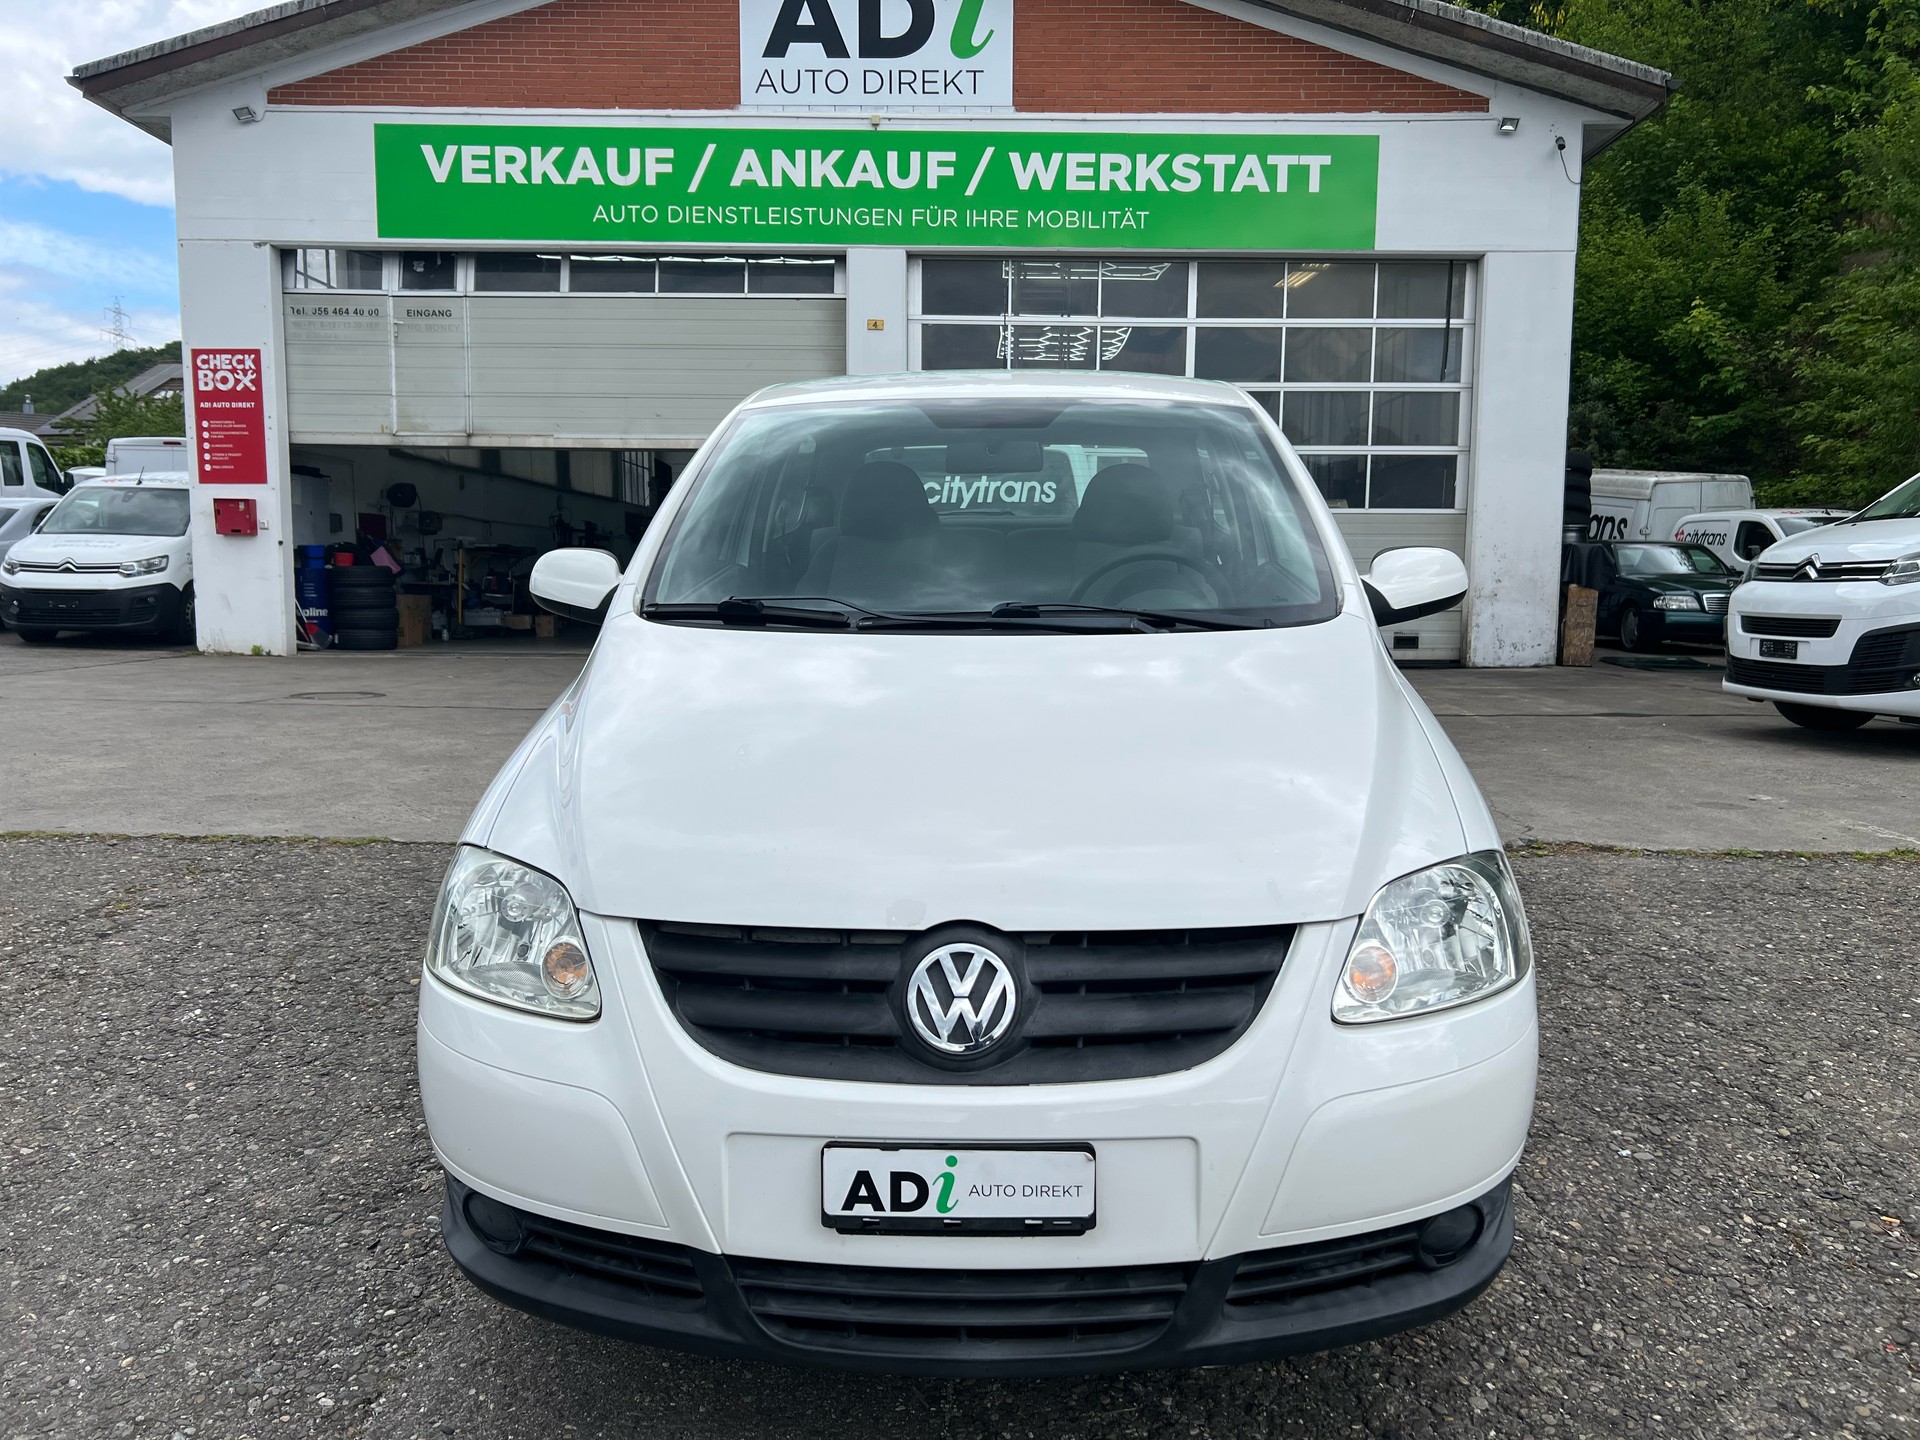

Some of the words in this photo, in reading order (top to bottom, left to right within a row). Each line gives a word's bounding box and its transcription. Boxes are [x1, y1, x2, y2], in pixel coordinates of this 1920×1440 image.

[755, 69, 848, 94] AUTO
[863, 70, 984, 94] DIREKT
[420, 145, 674, 186] VERKAUF
[687, 144, 717, 193] /
[730, 149, 956, 189] ANKAUF
[964, 147, 995, 196] /
[1009, 152, 1331, 193] WERKSTATT
[593, 205, 658, 223] AUTO
[668, 206, 902, 226] DIENSTLEISTUNGEN
[912, 206, 957, 227] FÜR
[966, 210, 1018, 228] IHRE
[1027, 208, 1150, 229] MOBILITÄT
[332, 307, 350, 316] 464
[406, 309, 453, 318] EINGANG
[196, 354, 256, 369] CHECK
[198, 370, 257, 391] BOX
[924, 476, 1057, 509] citytrans
[968, 1184, 1016, 1197] AUTO
[1022, 1185, 1083, 1197] DIREKT
